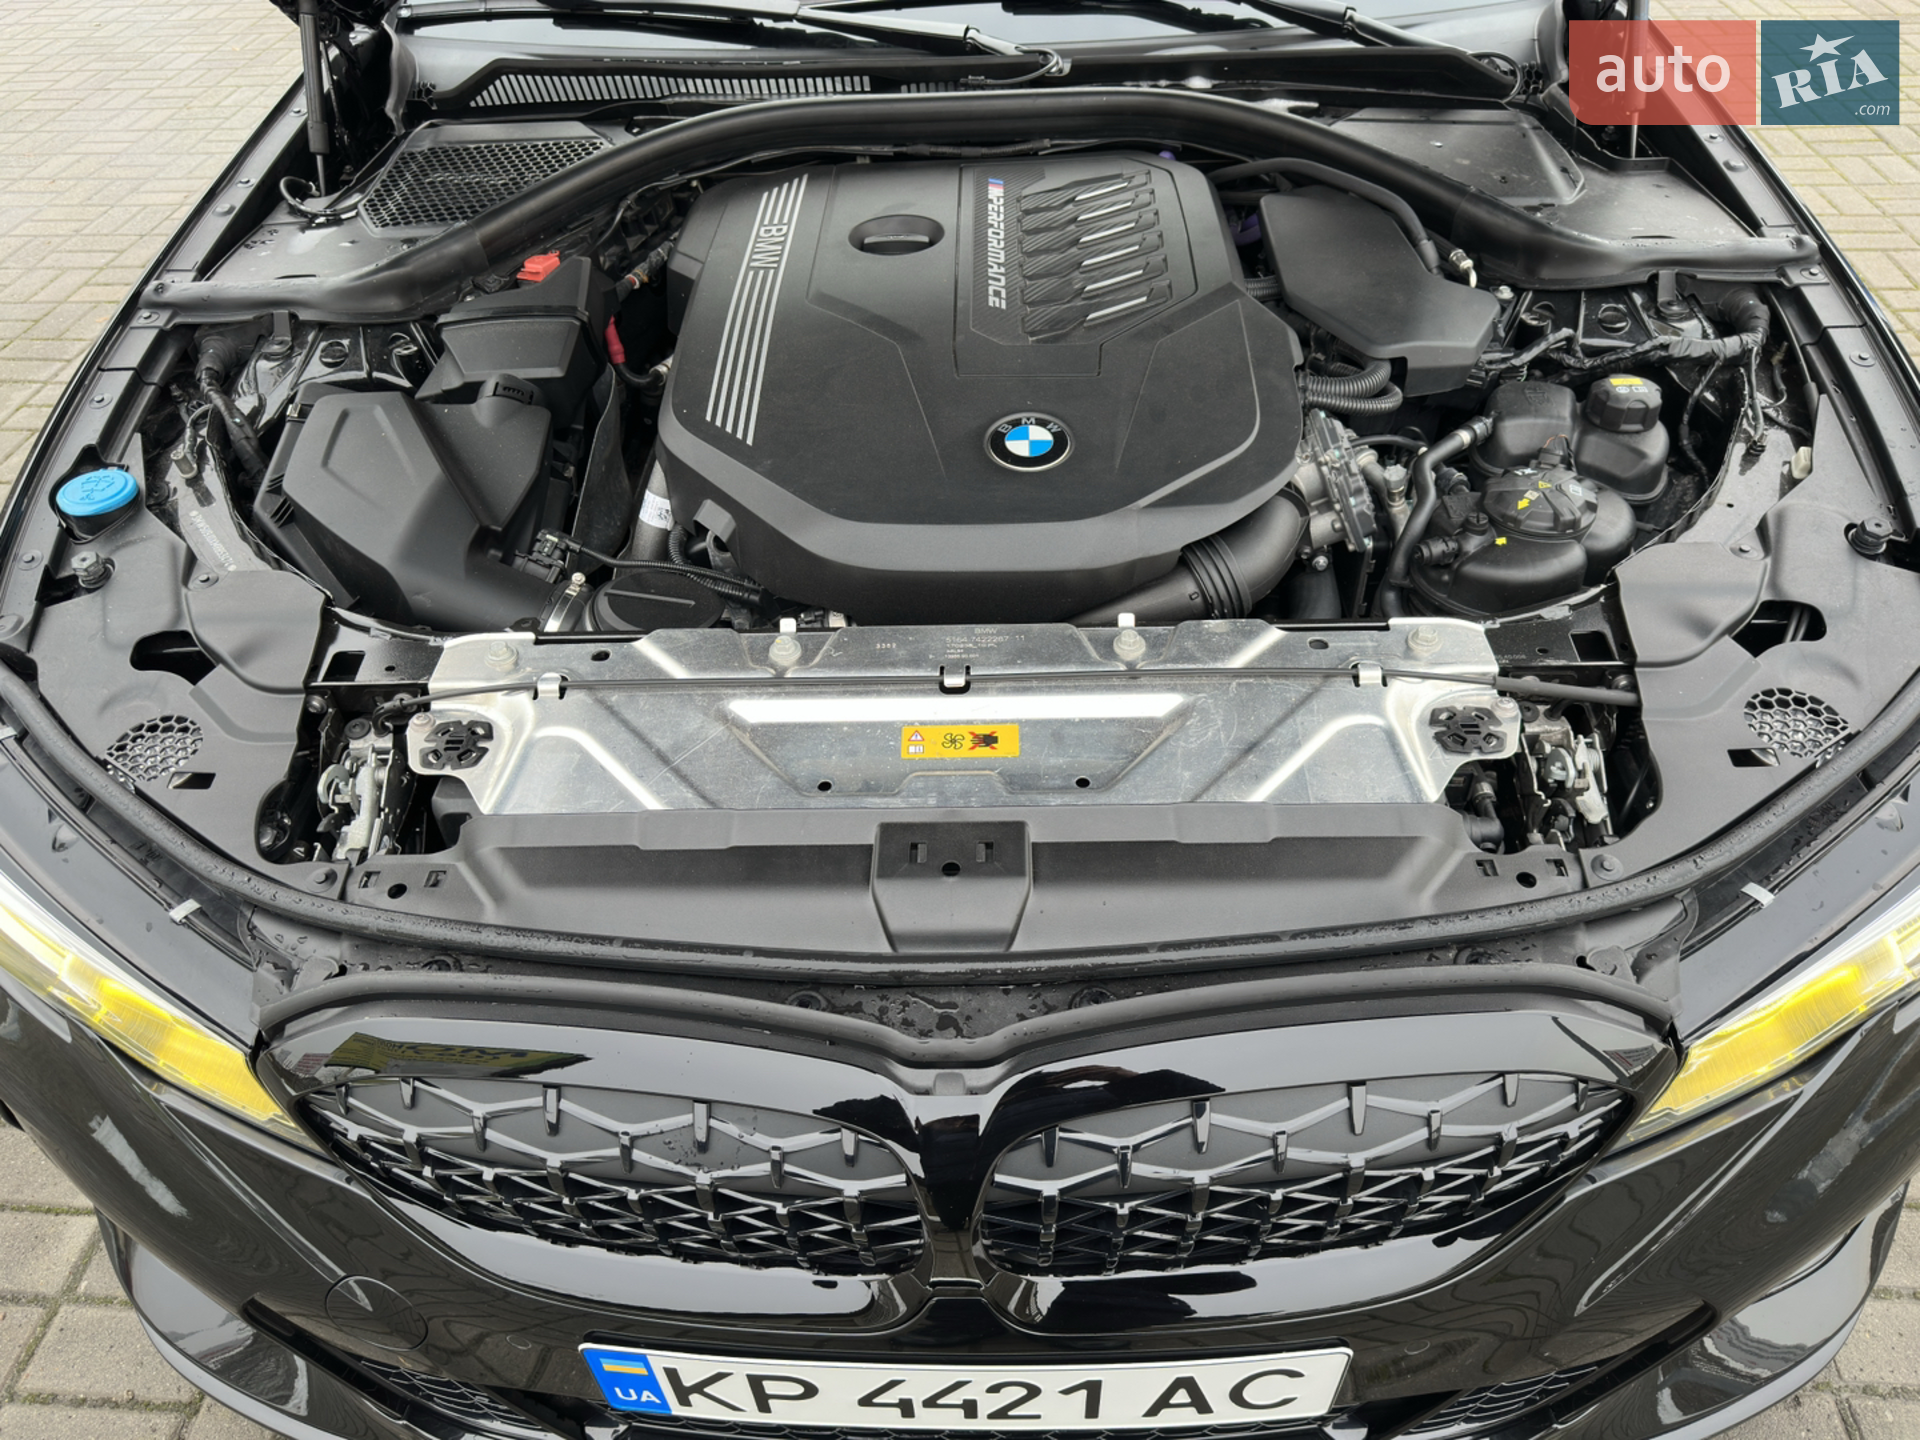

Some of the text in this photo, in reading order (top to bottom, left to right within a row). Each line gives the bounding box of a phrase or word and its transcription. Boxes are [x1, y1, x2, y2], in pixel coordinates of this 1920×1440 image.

[749, 225, 788, 268] BMW
[998, 418, 1061, 433] BMW
[614, 1387, 662, 1404] UA
[662, 1366, 1305, 1420] KP 4421 AC
